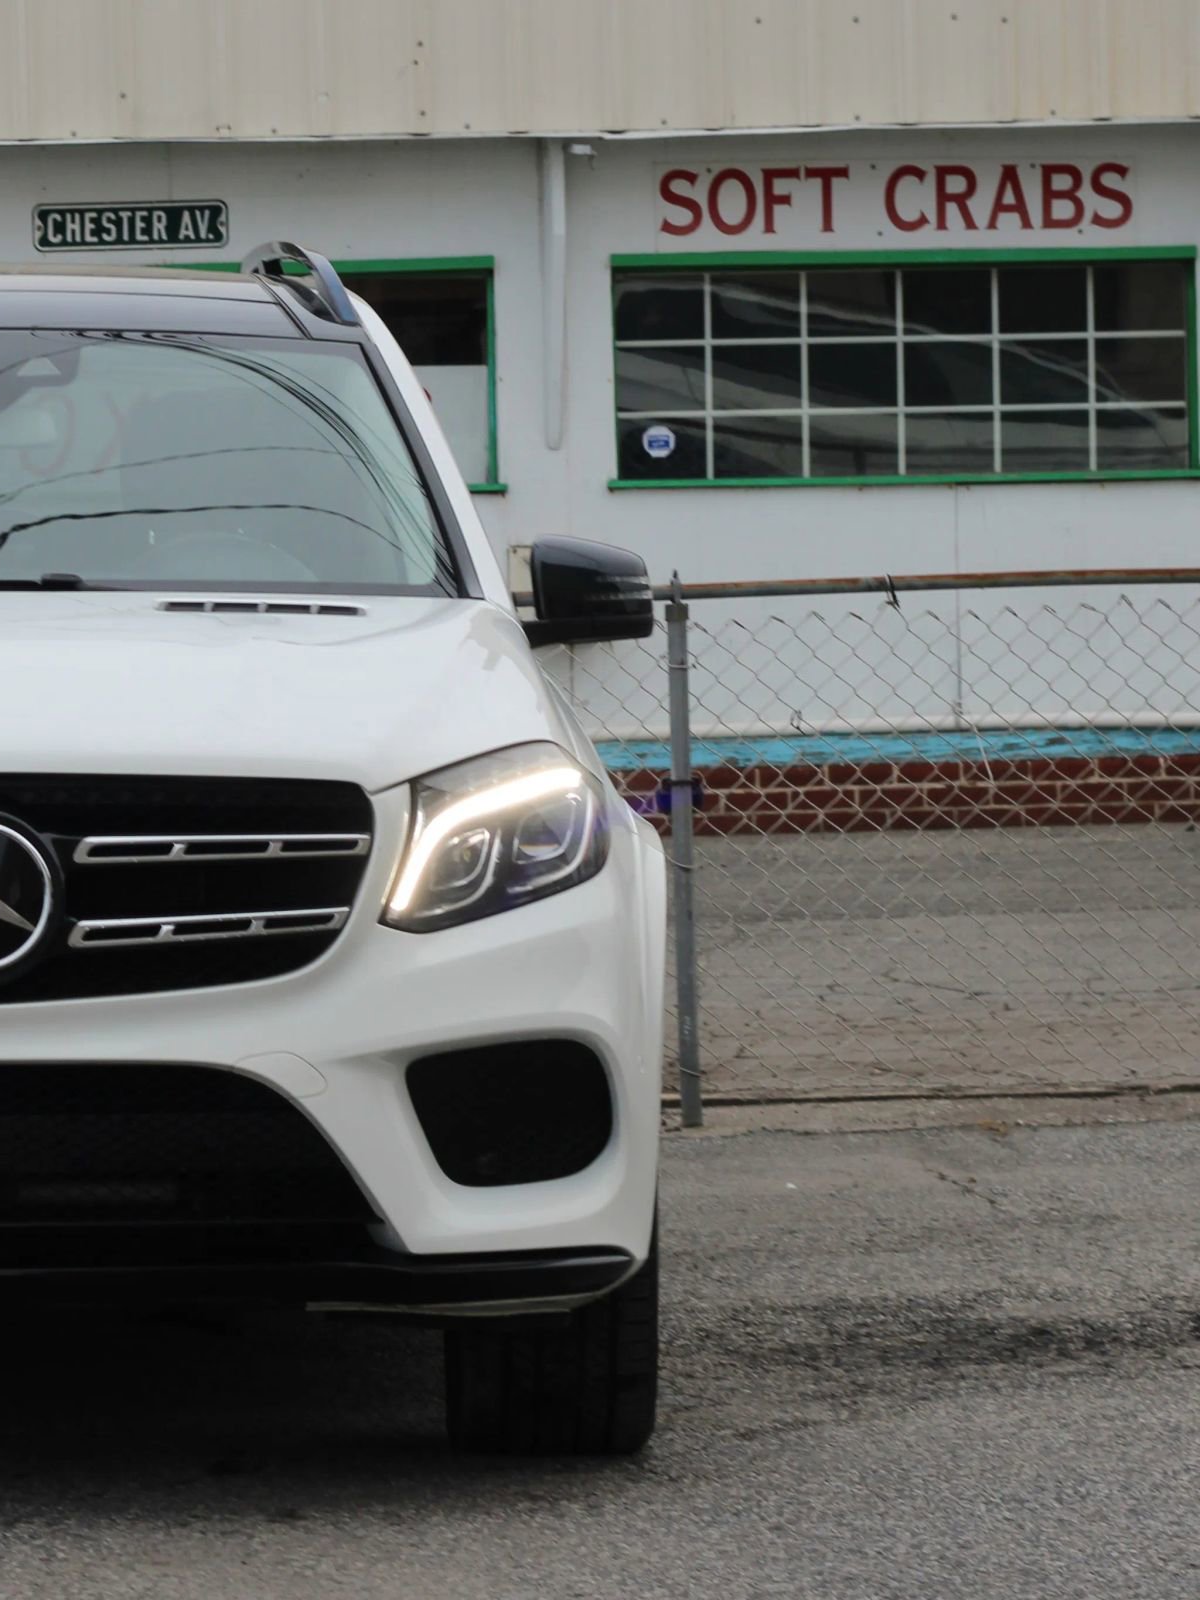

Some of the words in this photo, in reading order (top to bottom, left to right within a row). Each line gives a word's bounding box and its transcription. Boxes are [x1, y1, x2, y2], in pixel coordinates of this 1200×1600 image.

[46, 210, 168, 243] CHESTER
[178, 209, 215, 240] AV.
[659, 166, 850, 237] SOFT
[883, 162, 1134, 232] CRABS
